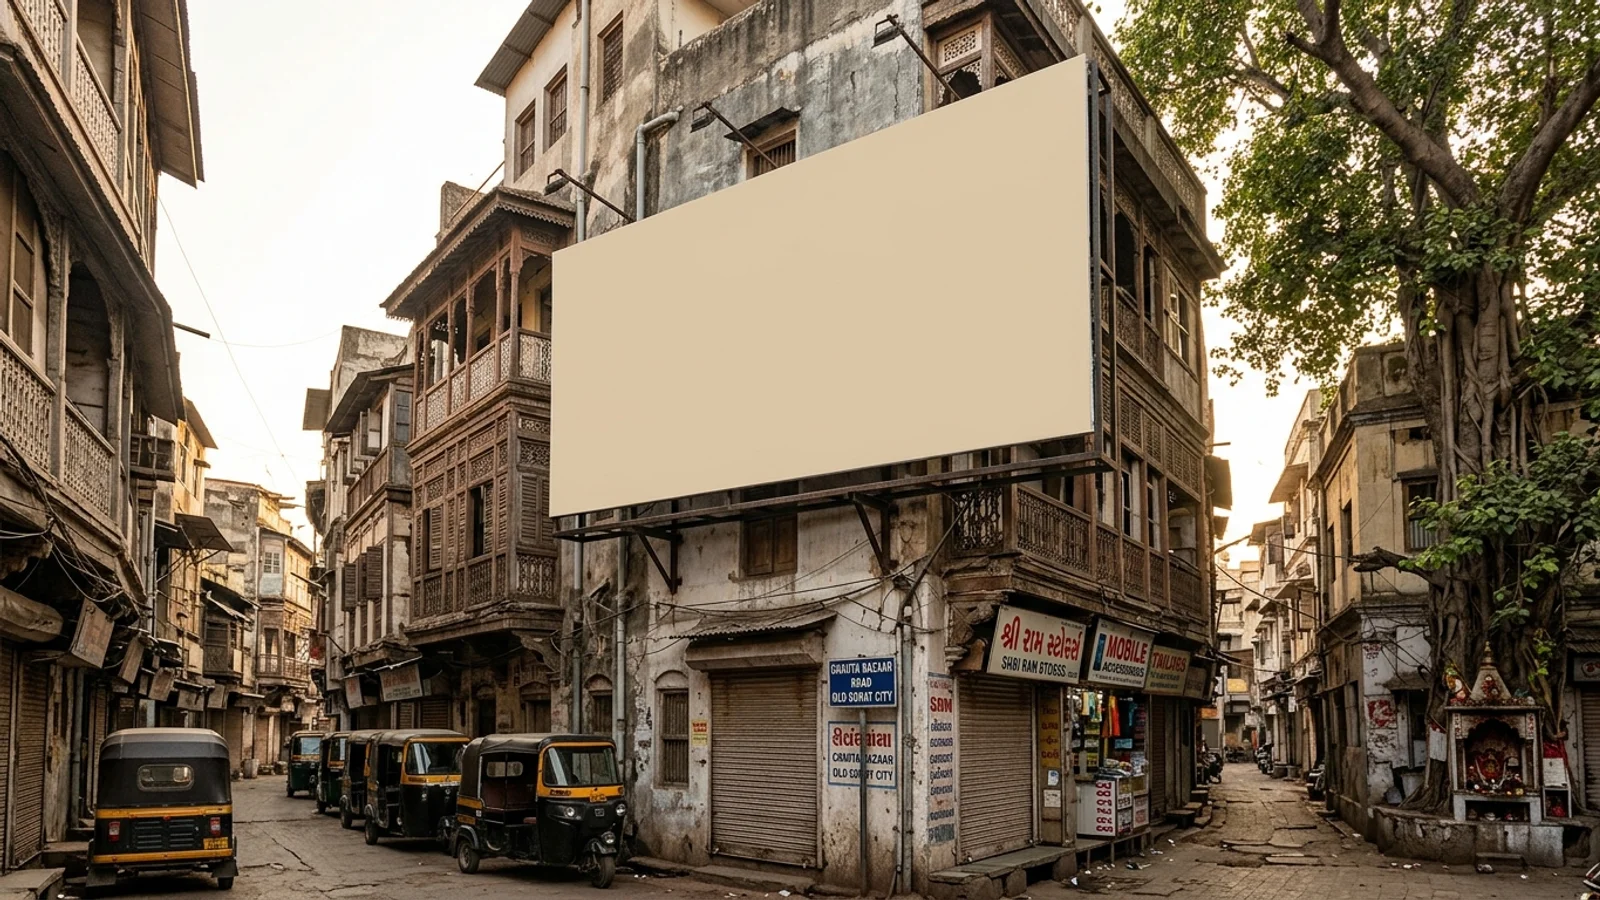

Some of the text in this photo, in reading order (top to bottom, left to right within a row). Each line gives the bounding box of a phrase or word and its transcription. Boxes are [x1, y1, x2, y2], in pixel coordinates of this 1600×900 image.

[1106, 634, 1148, 664] MOBILE
[875, 690, 893, 702] CITY
[876, 770, 893, 780] CITY
